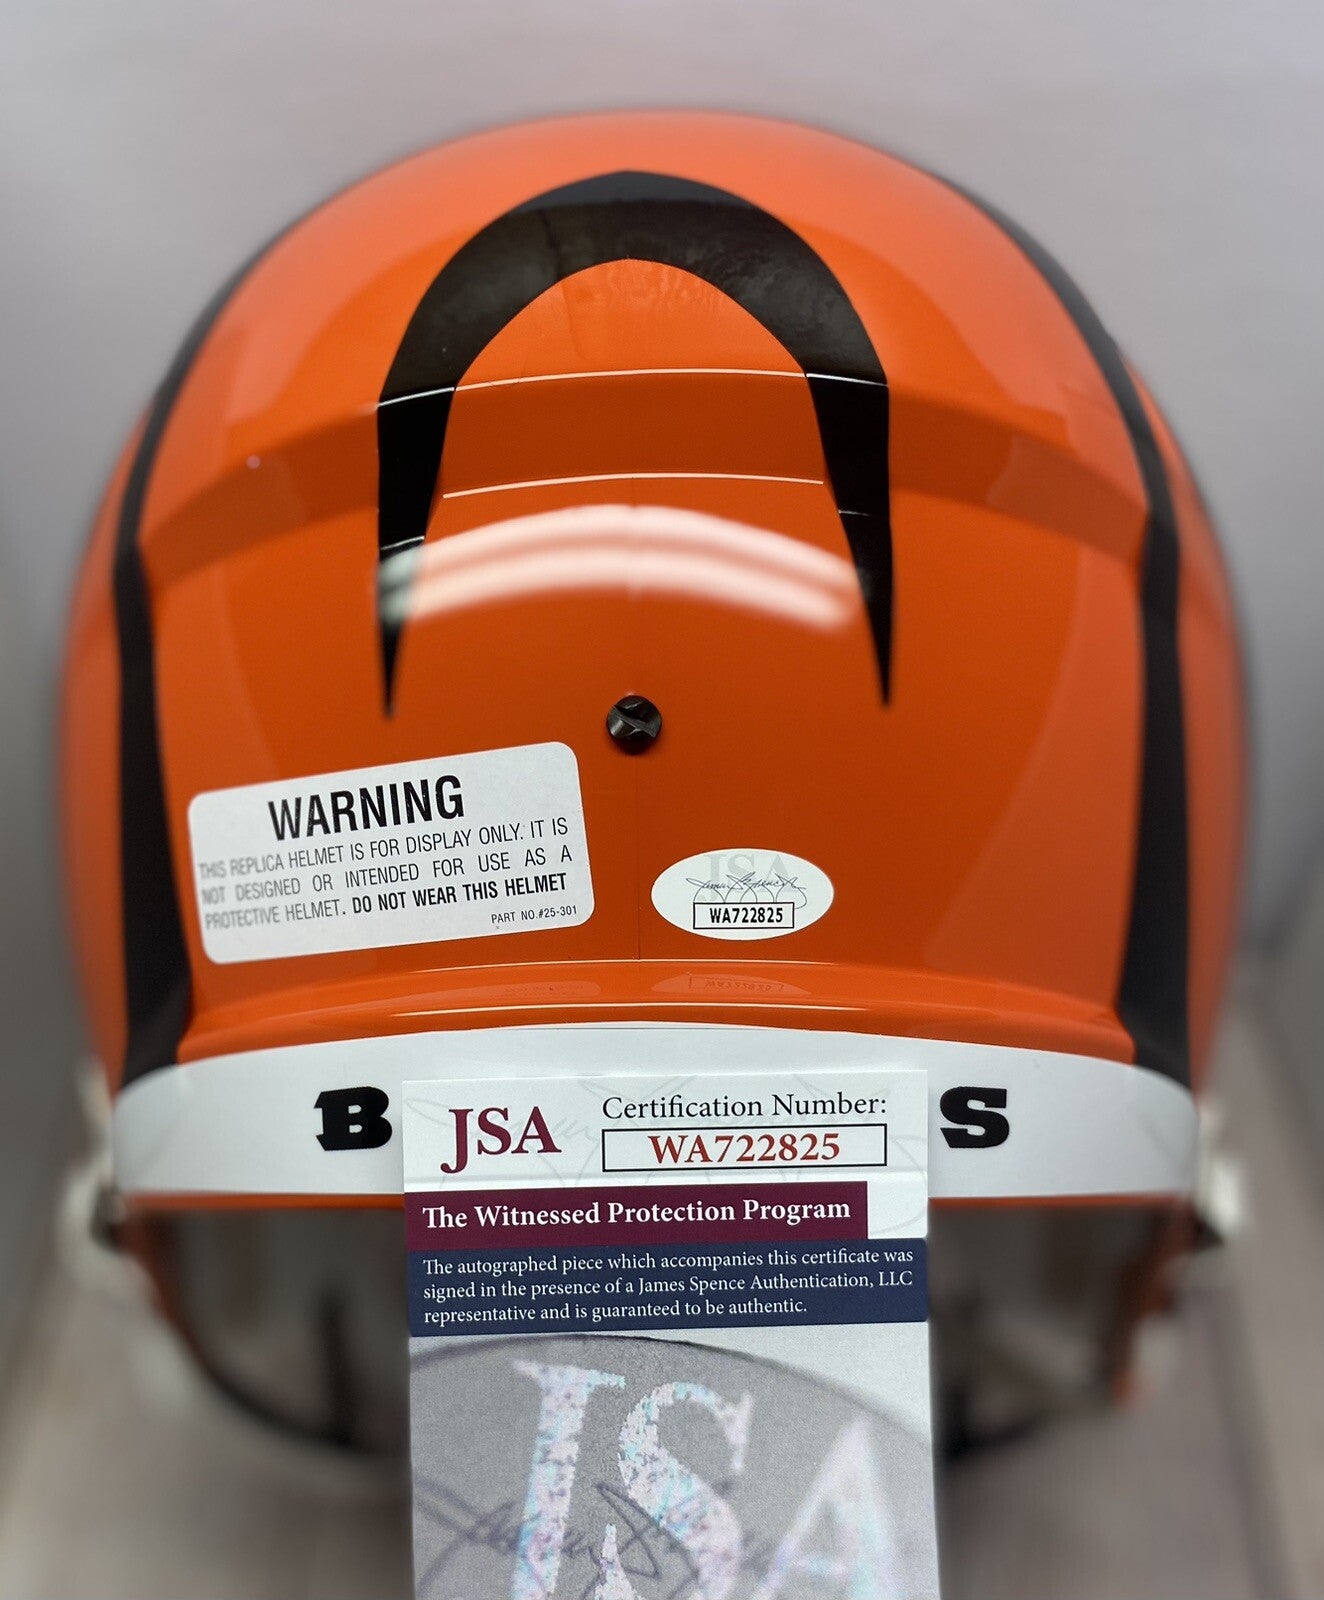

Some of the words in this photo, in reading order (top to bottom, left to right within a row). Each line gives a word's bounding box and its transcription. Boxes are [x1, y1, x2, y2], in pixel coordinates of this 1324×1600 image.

[268, 775, 464, 841] WARNING
[198, 861, 227, 879] THIS
[230, 853, 285, 876] REPLICA
[288, 845, 344, 869] HELMET
[350, 843, 364, 861] IS
[370, 838, 400, 858] FOR
[406, 829, 471, 854] DISPLAY
[479, 822, 523, 844] ONLY.
[531, 820, 544, 838] IT
[552, 817, 568, 836] IS
[202, 886, 226, 904] NOT
[235, 877, 300, 901] DESIGNED
[312, 873, 334, 892] OR
[345, 863, 419, 888] INTENDED
[433, 858, 465, 878] FOR
[478, 852, 511, 872] USE
[524, 848, 546, 867] AS
[560, 844, 572, 862] A
[204, 906, 280, 931] PROTECTIVE
[285, 899, 346, 922] HELMET.
[352, 895, 372, 914] DO
[378, 891, 406, 911] NOT
[412, 886, 457, 907] WEAR
[462, 881, 498, 901] THIS
[505, 873, 567, 896] HELMET
[491, 912, 516, 924] PART
[709, 907, 783, 924] WA722825
[602, 1095, 763, 1120] Certification
[771, 1091, 887, 1117] Number:
[440, 1105, 562, 1174] JSA
[648, 1132, 840, 1164] WA722825
[422, 1206, 468, 1229] The
[474, 1201, 601, 1227] Witnessed
[607, 1201, 736, 1223] Protection
[743, 1199, 851, 1226] Program
[423, 1259, 453, 1275] The
[457, 1255, 557, 1277] autographed
[562, 1256, 603, 1275] piece
[608, 1253, 656, 1270] which
[661, 1252, 763, 1271] accompanies
[768, 1250, 797, 1265] this
[801, 1248, 879, 1264] certificate
[883, 1250, 913, 1262] was
[423, 1282, 475, 1303] signed
[480, 1283, 496, 1297] in
[501, 1281, 526, 1296] the
[531, 1282, 600, 1299] presence
[605, 1277, 623, 1294] of
[625, 1282, 634, 1292] a
[638, 1277, 685, 1295] James
[690, 1276, 745, 1295] Spence
[750, 1274, 873, 1290] Authentication,
[879, 1271, 913, 1287] LLC
[424, 1306, 536, 1327] representative
[540, 1303, 569, 1319] and
[575, 1304, 587, 1318] is
[592, 1301, 680, 1322] guaranteed
[685, 1303, 700, 1315] to
[706, 1299, 724, 1314] be
[729, 1298, 807, 1314] authentic.
